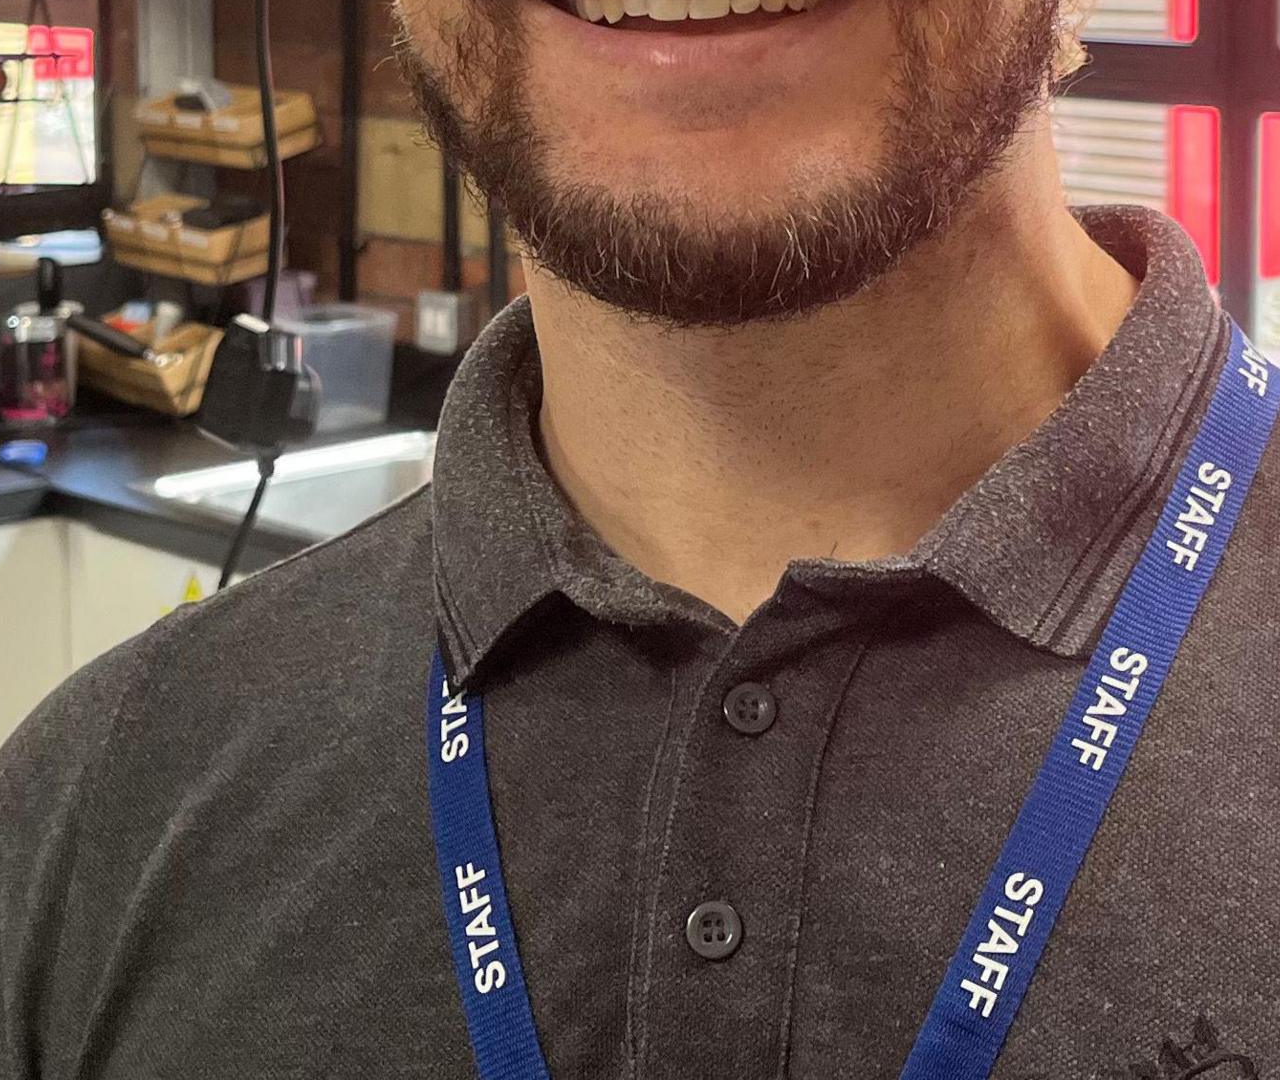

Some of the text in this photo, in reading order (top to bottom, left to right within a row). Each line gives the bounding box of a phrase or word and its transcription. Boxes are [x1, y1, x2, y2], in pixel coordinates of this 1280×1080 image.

[1166, 461, 1231, 572] STAFF
[1071, 646, 1148, 772] STAFF
[455, 862, 506, 994] STAFF
[960, 871, 1045, 1019] STAFF
